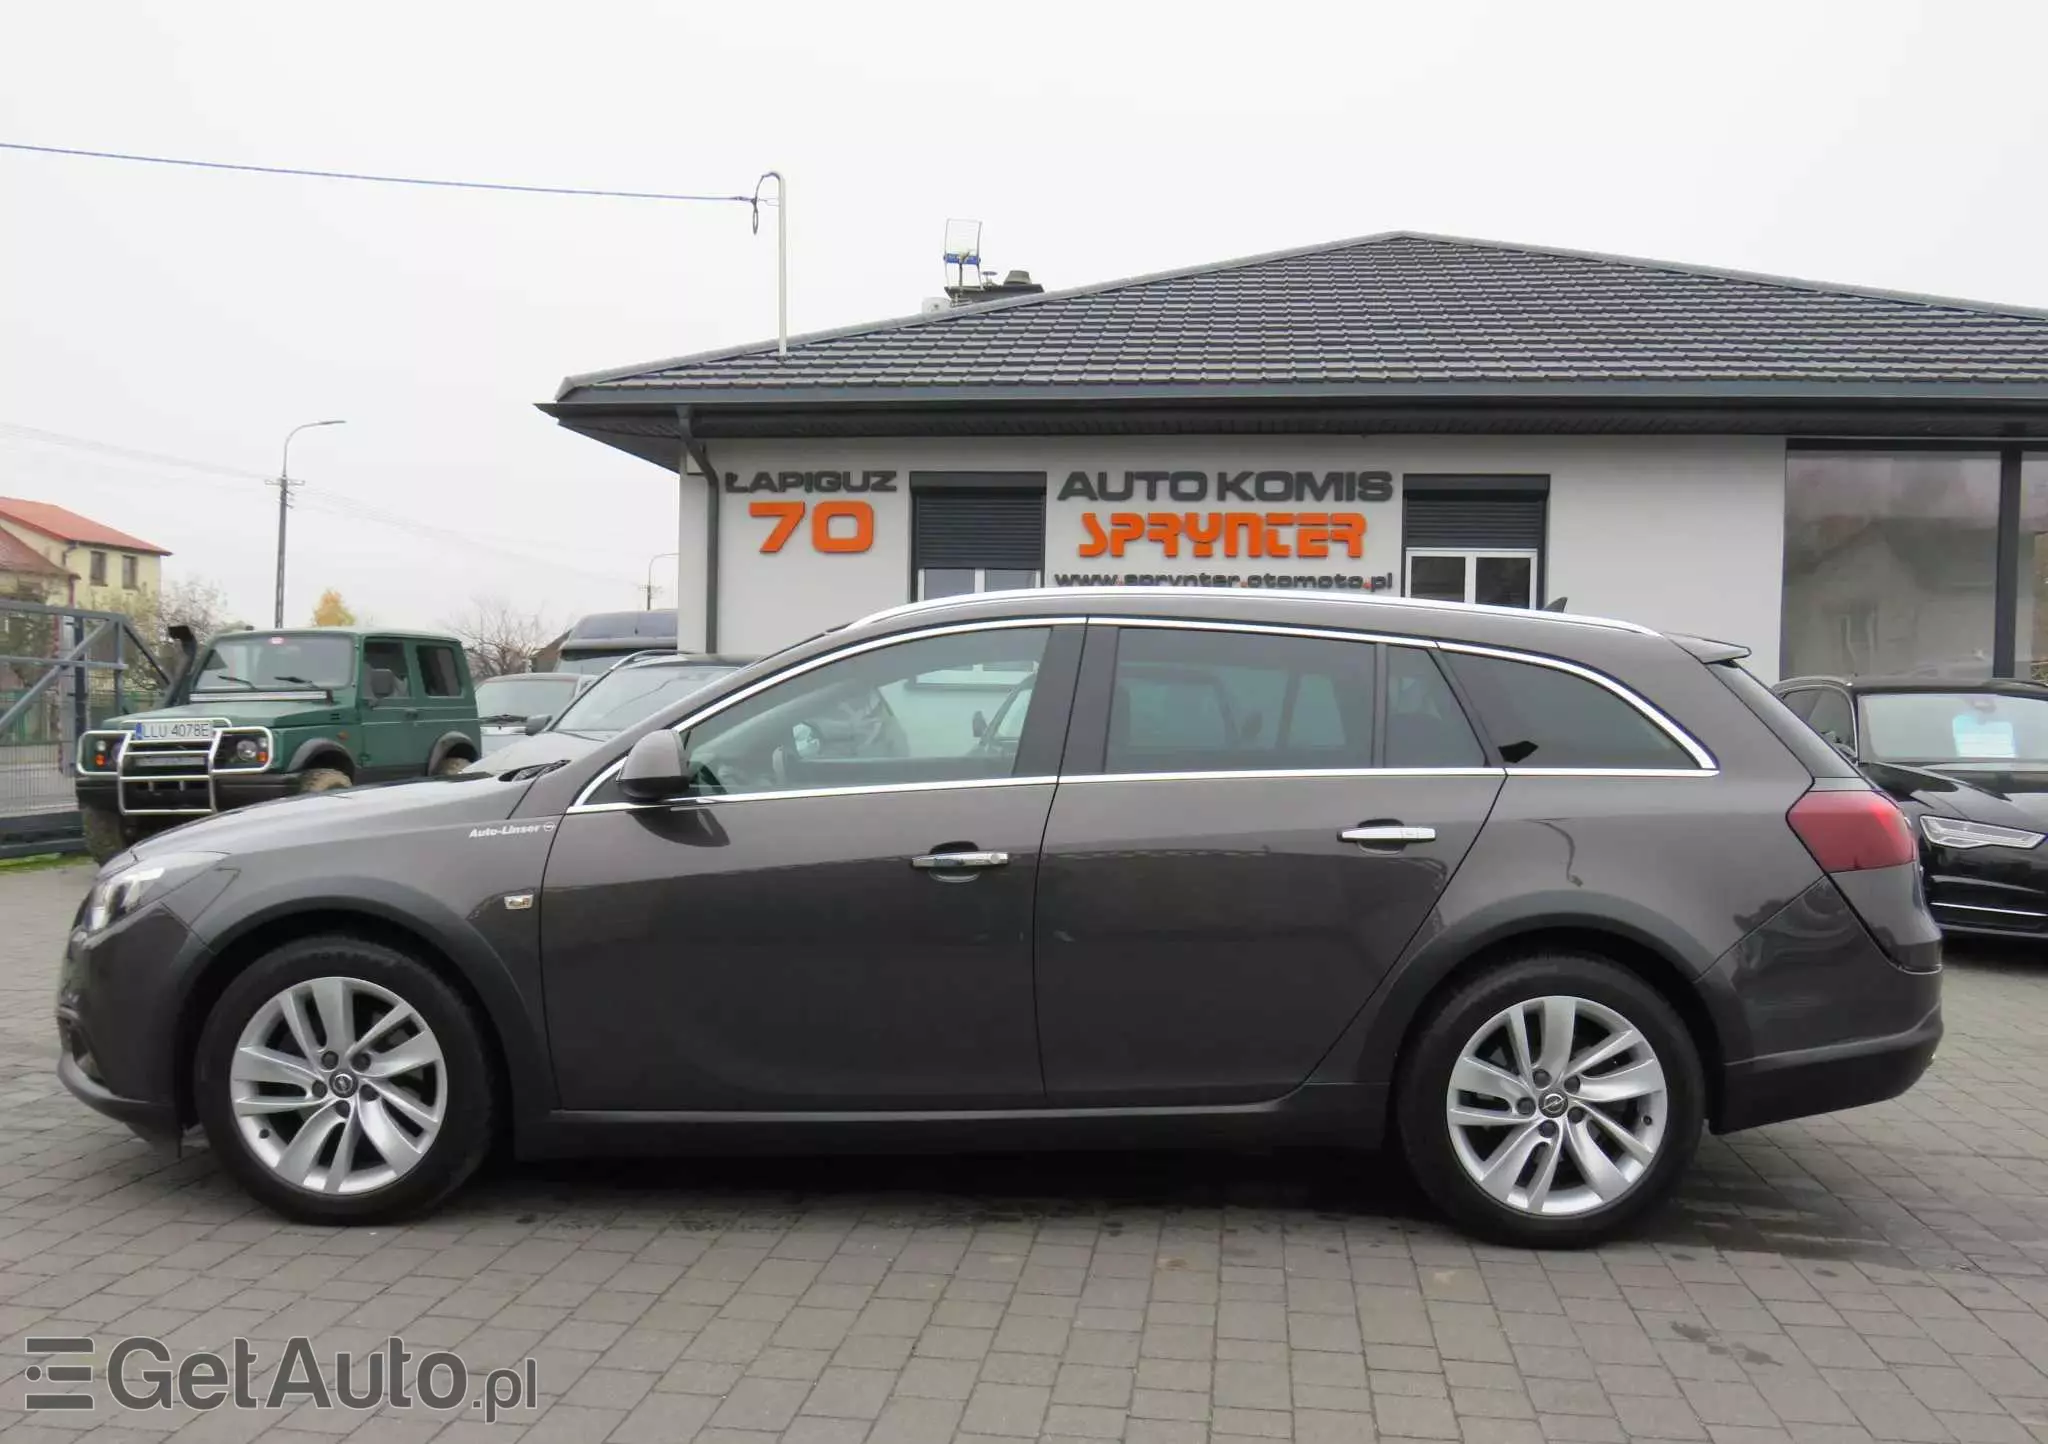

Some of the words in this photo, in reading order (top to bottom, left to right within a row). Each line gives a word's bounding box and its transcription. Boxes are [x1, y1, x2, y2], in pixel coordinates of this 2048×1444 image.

[724, 470, 897, 493] ŁAPIGUZ
[1057, 471, 1208, 501] AUTO
[1216, 471, 1393, 502] KOMIS
[748, 501, 874, 554] 70
[1078, 512, 1367, 558] SPRYNTER
[143, 722, 167, 738] LLU
[171, 723, 209, 737] 4078E
